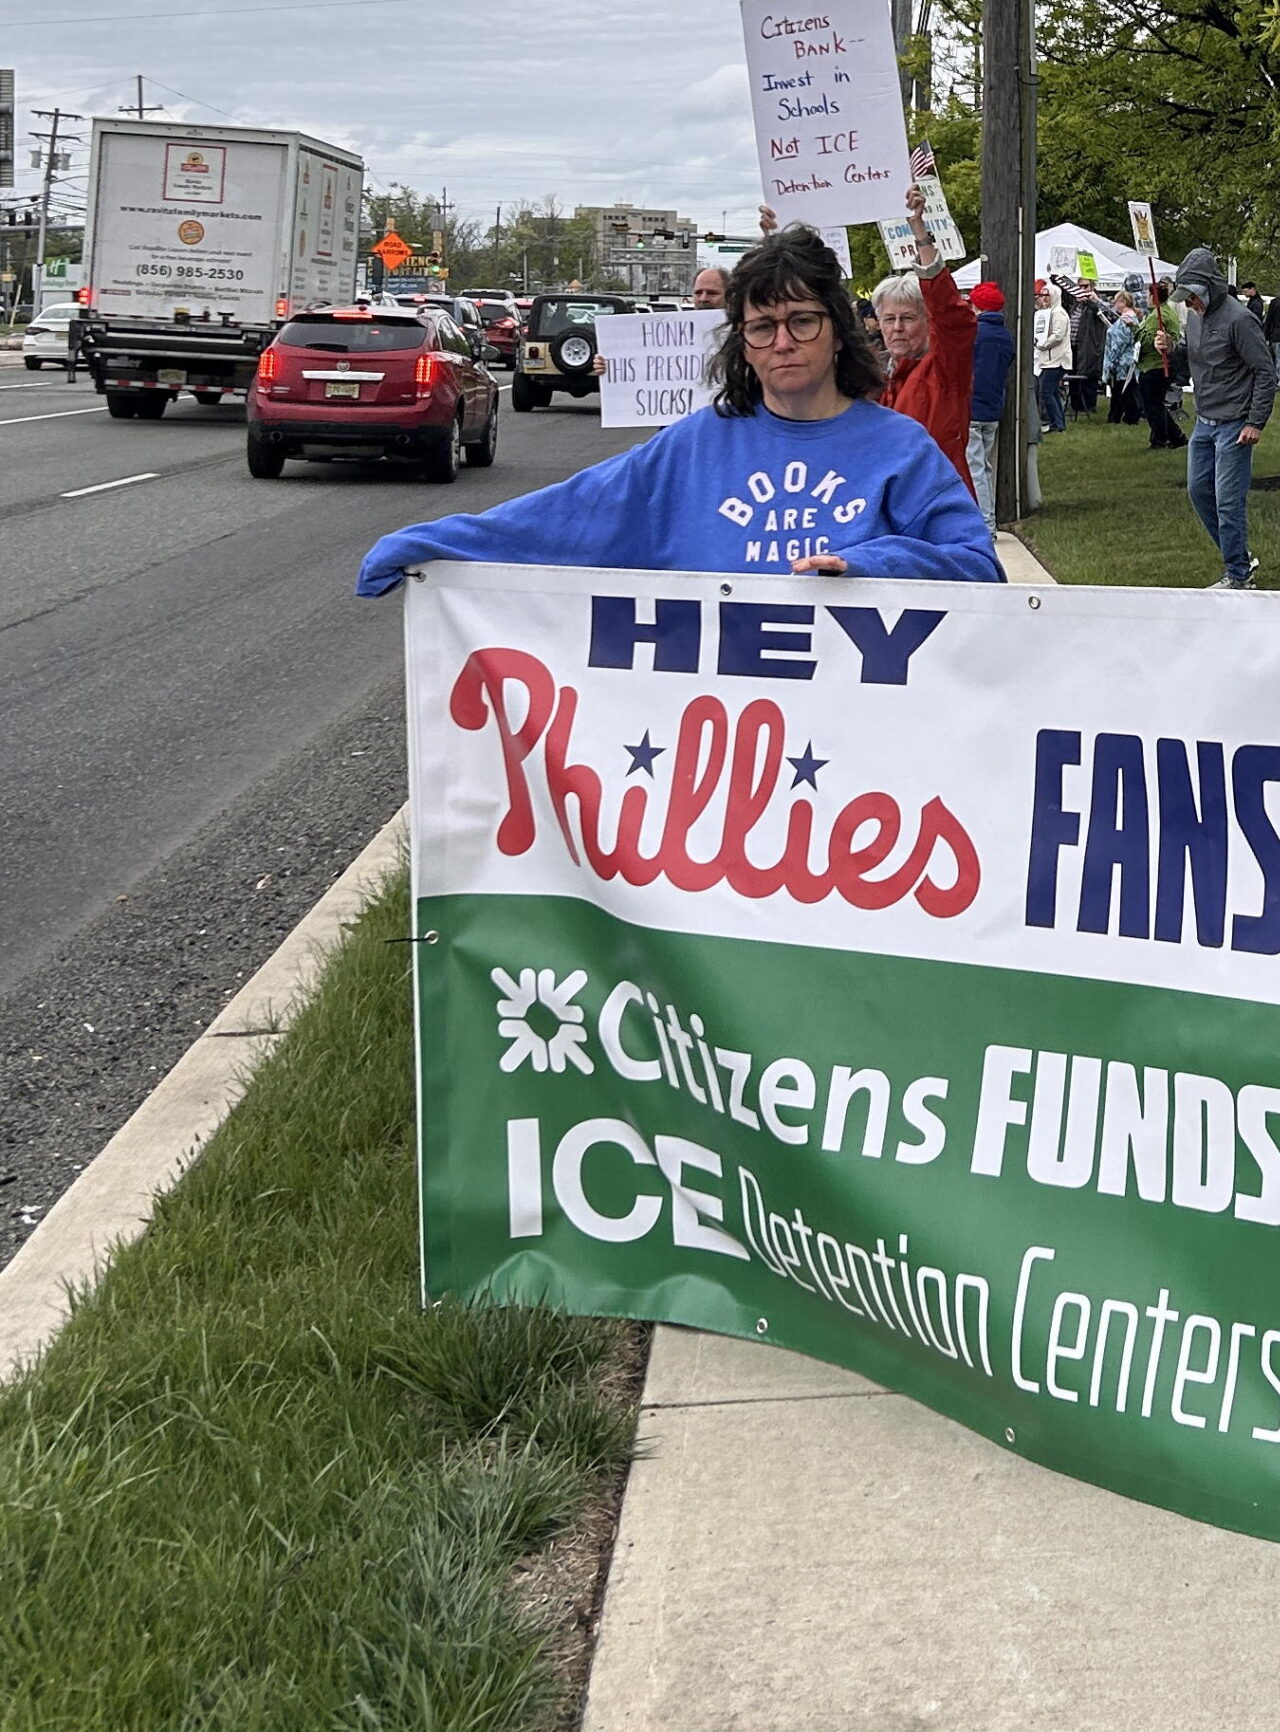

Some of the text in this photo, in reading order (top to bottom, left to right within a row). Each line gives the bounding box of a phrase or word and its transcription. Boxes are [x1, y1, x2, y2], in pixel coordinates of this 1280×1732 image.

[760, 15, 831, 39] Citizens
[762, 65, 851, 92] Invest in
[777, 92, 841, 121] Schools
[770, 130, 859, 159] Not ICE
[771, 163, 891, 196] Detention Centers
[136, 263, 244, 281] (856) 985-2530
[642, 321, 695, 348] HONK!
[606, 352, 710, 384] THIS PRESID
[635, 387, 694, 417] SUCKS!
[718, 461, 867, 528] BOOKS
[764, 507, 818, 532] ARE
[744, 535, 830, 563] MAGIC
[587, 595, 949, 686] HEY
[450, 647, 981, 919] Phillies
[598, 979, 949, 1166] Citizens
[506, 1117, 752, 1261] ICE
[737, 1164, 994, 1378] Detention
